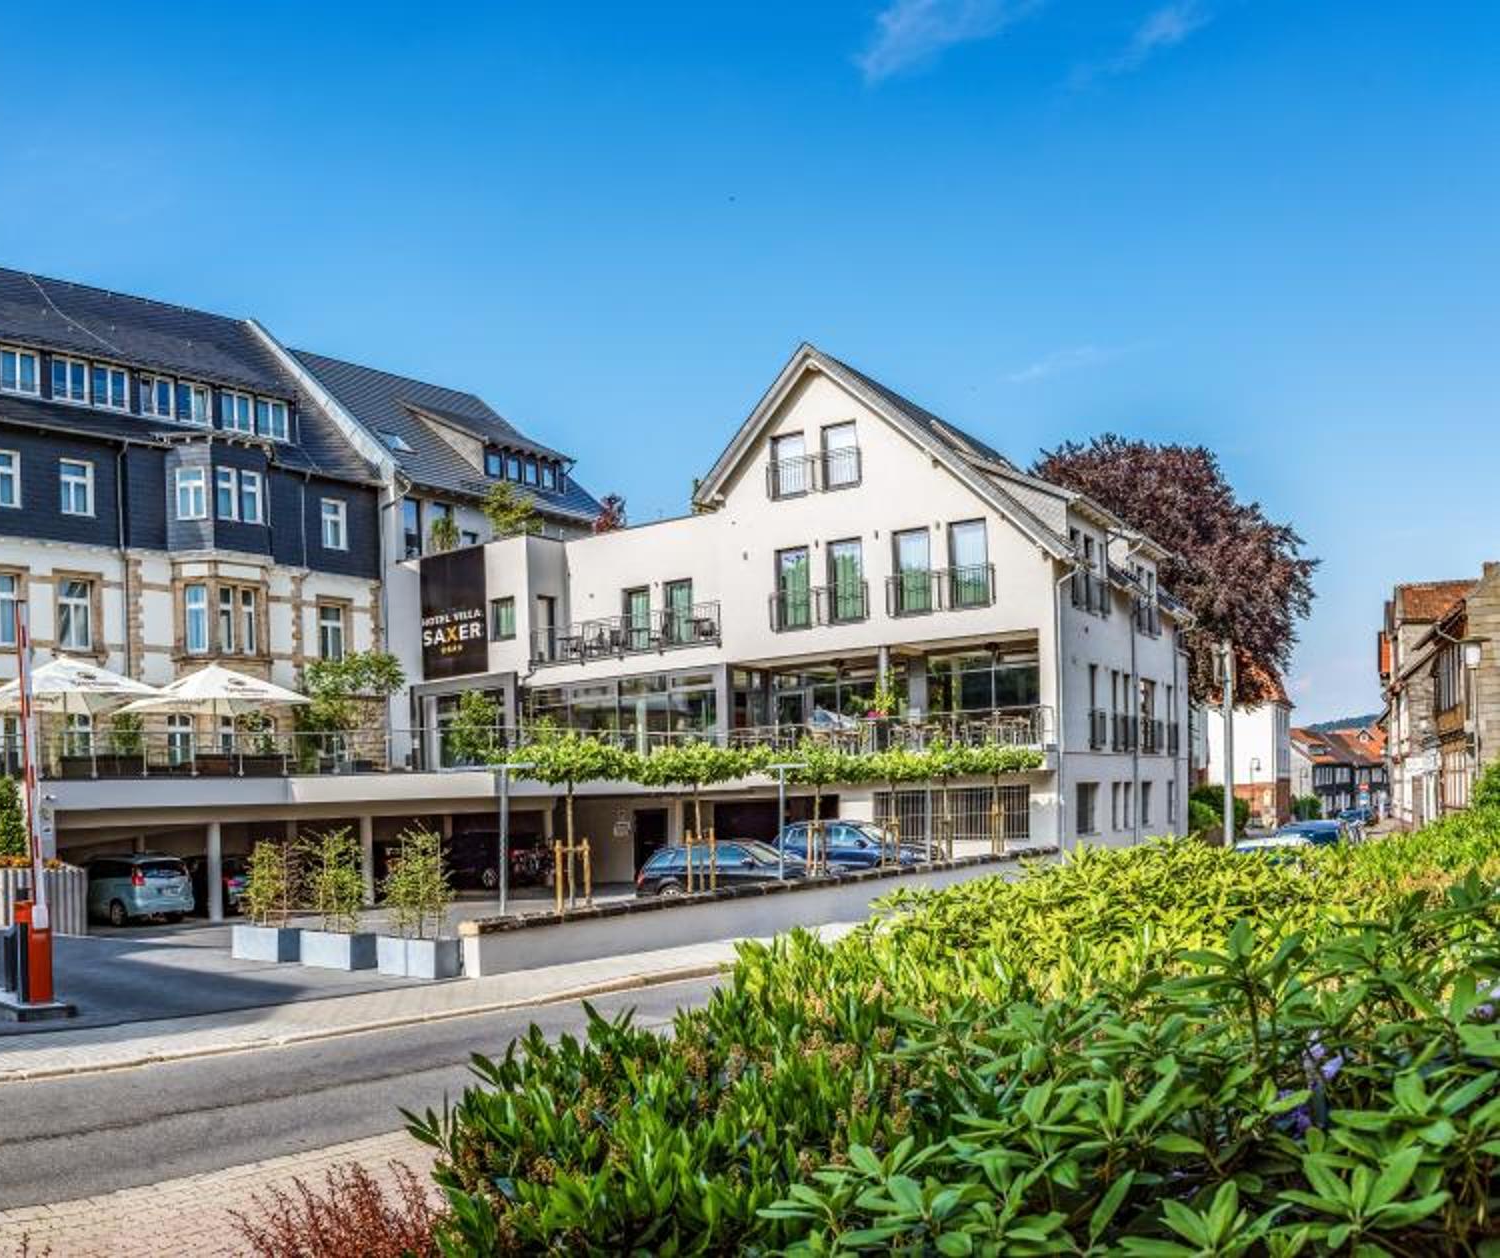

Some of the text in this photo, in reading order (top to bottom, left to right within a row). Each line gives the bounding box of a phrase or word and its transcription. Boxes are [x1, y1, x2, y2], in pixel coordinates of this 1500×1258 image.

[421, 608, 481, 627] HOTEL VILLA
[423, 622, 481, 647] SAXER
